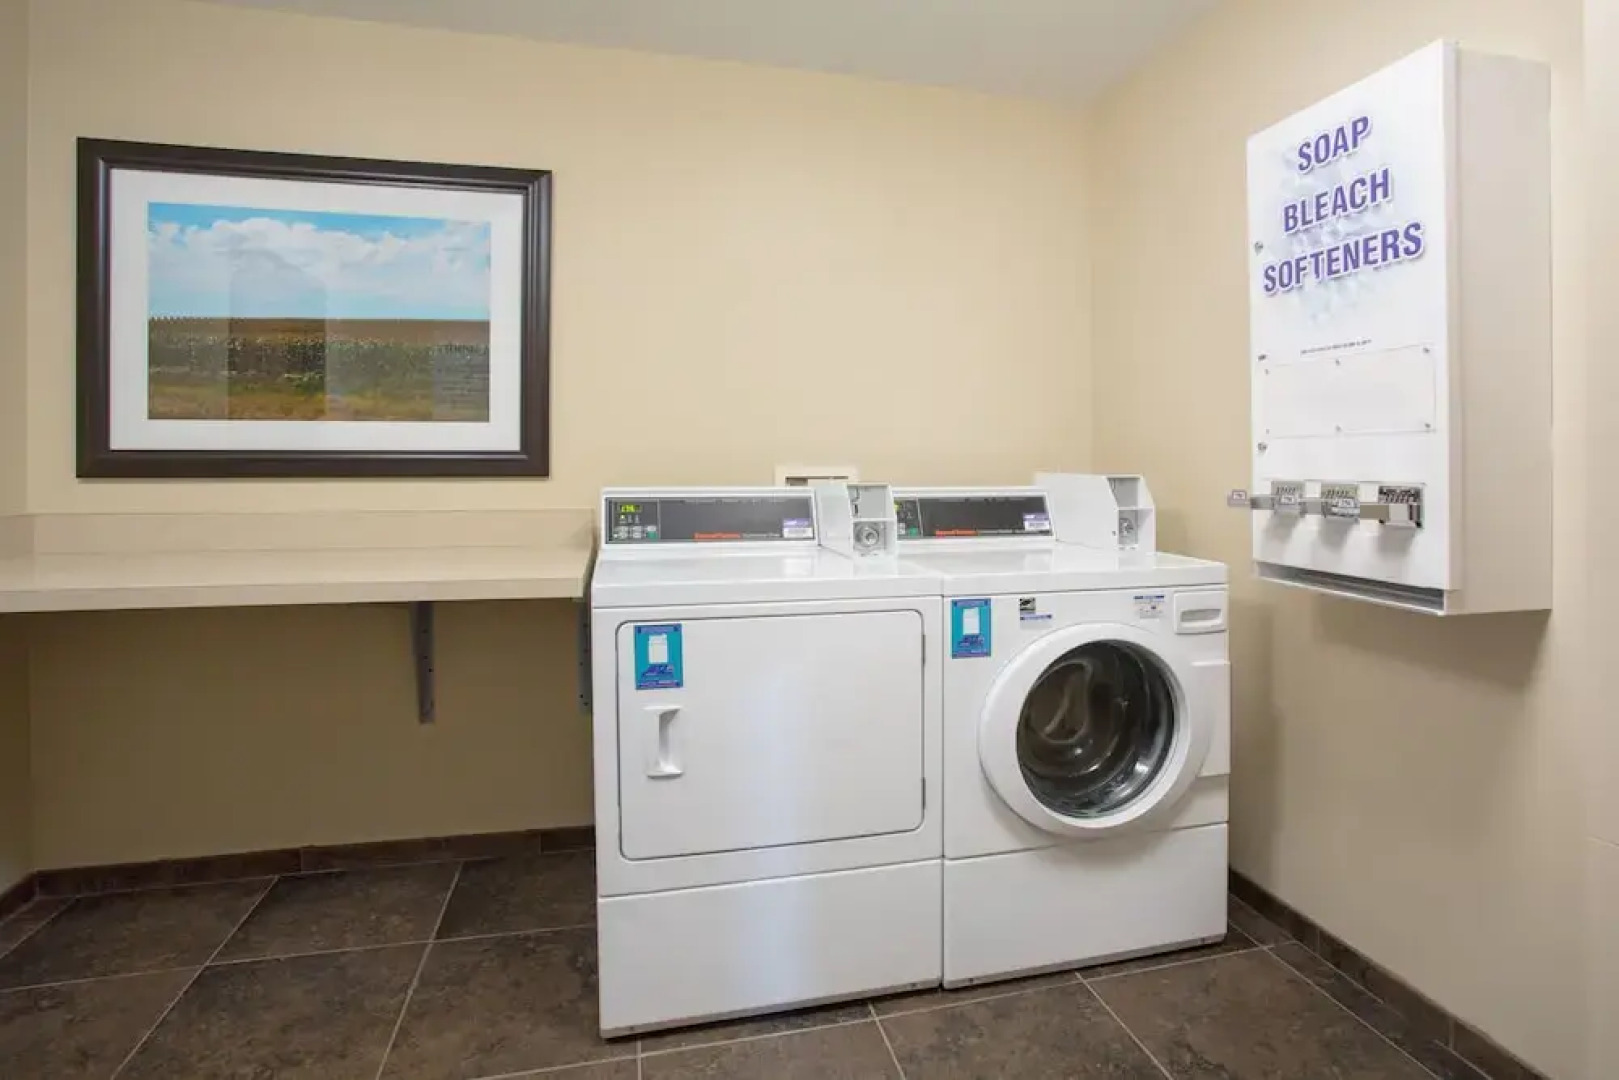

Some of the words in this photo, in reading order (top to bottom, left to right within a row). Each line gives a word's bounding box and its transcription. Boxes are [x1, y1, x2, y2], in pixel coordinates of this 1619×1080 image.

[1297, 115, 1369, 171] SOAP
[1283, 167, 1389, 232] BLEACH
[1263, 221, 1422, 292] SOFTENERS
